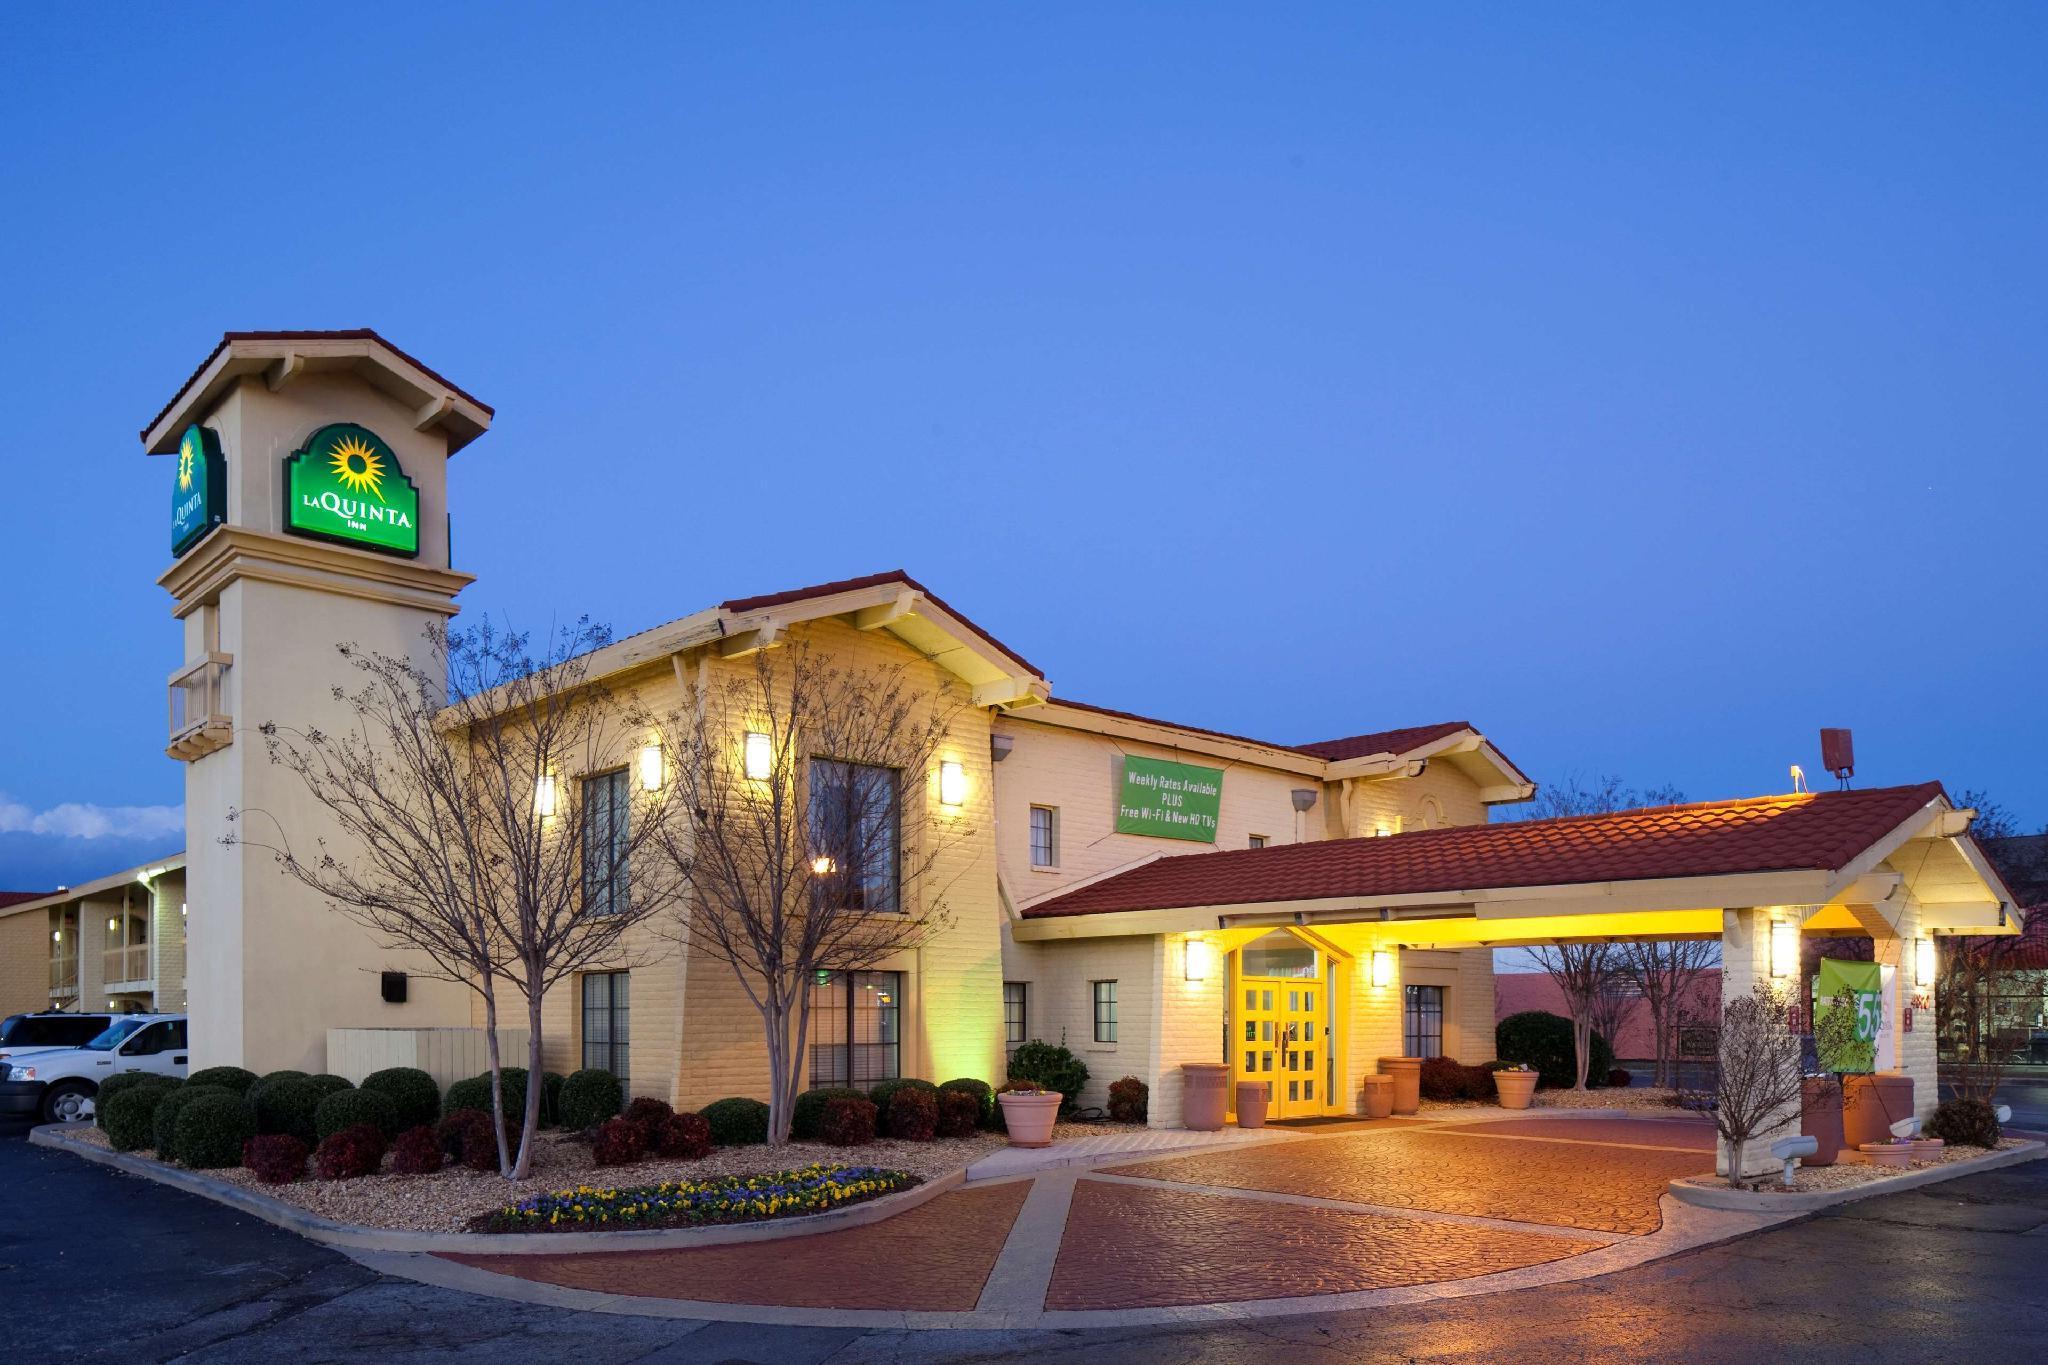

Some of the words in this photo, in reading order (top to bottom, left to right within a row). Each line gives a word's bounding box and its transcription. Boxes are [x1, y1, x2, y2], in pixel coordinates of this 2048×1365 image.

[347, 520, 367, 531] INN
[1128, 771, 1158, 790] Weekly
[1159, 775, 1181, 791] Rates
[1182, 780, 1217, 796] Available
[1161, 793, 1183, 807] PLUS
[1120, 805, 1139, 818] Free
[1165, 810, 1171, 822] &
[1172, 811, 1188, 824] New
[1189, 813, 1200, 826] HD
